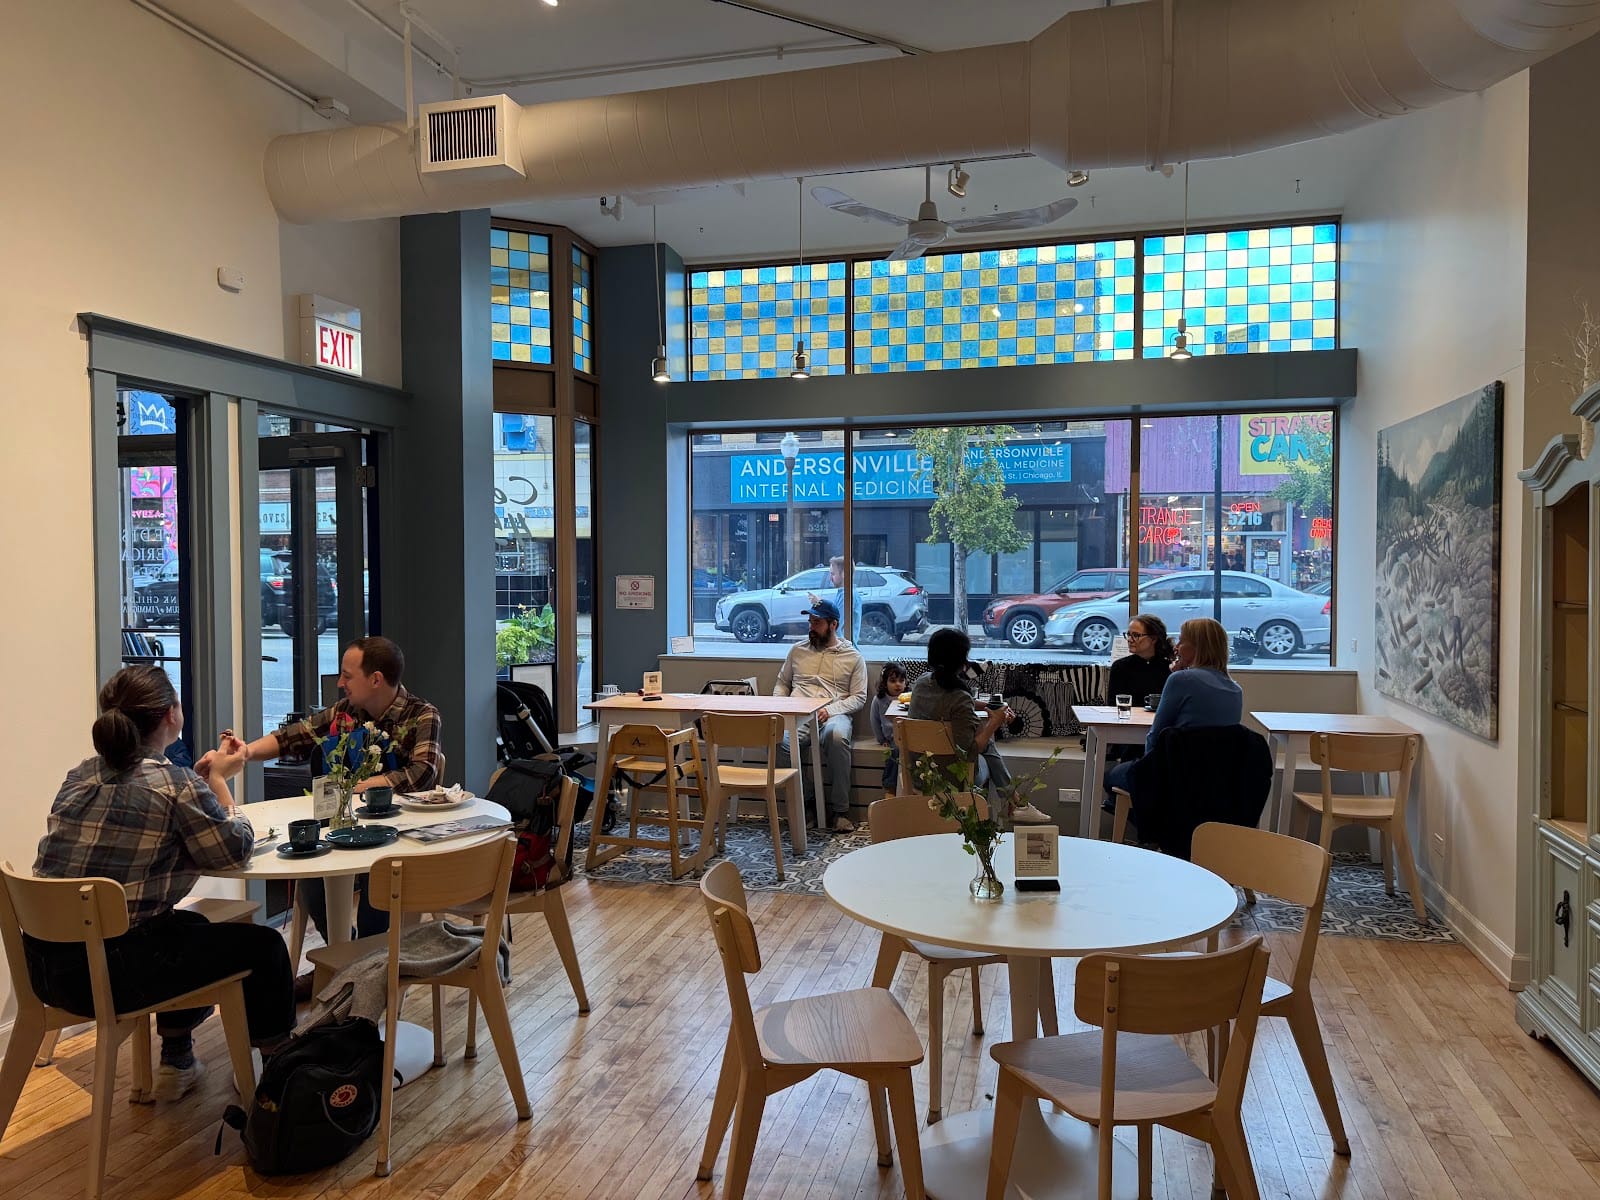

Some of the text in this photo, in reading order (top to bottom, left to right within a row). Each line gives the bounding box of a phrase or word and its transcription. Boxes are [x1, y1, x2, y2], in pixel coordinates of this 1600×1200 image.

[320, 325, 354, 370] EXIT
[740, 454, 933, 477] ANDERSONVILLE
[1013, 459, 1065, 469] MEDICINE
[1230, 502, 1261, 513] OPEN
[1227, 512, 1263, 526] 5216
